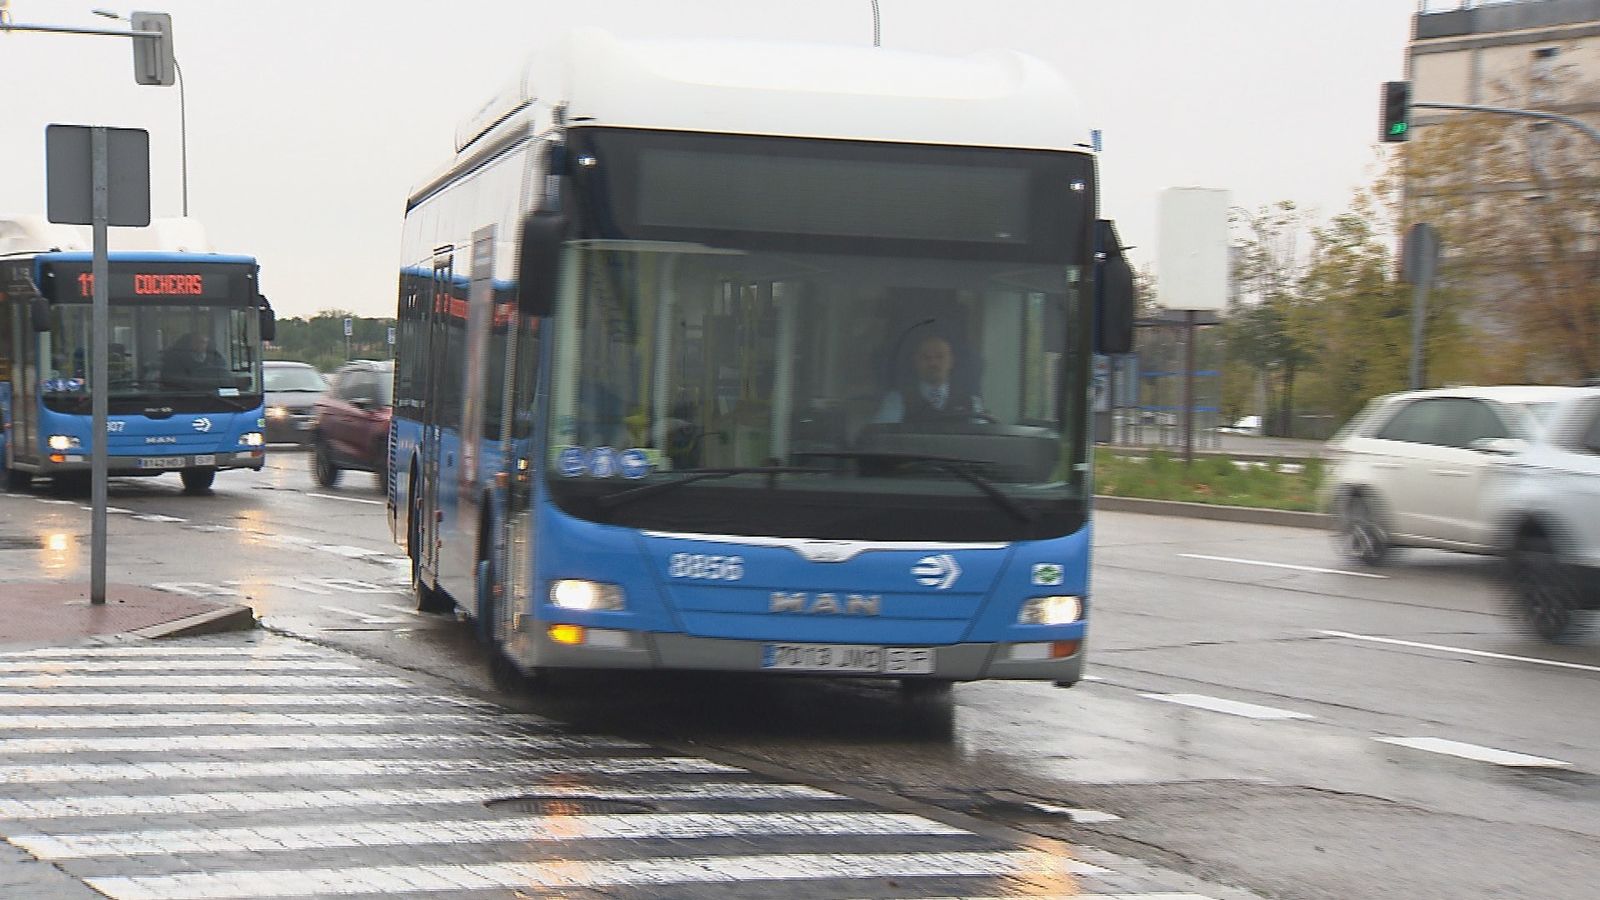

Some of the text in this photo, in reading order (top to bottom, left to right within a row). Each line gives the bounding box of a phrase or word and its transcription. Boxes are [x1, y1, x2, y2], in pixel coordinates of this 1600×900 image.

[134, 273, 202, 295] COCHERAS
[145, 436, 176, 444] MAN
[669, 552, 744, 581] 8856
[769, 591, 881, 616] MAN
